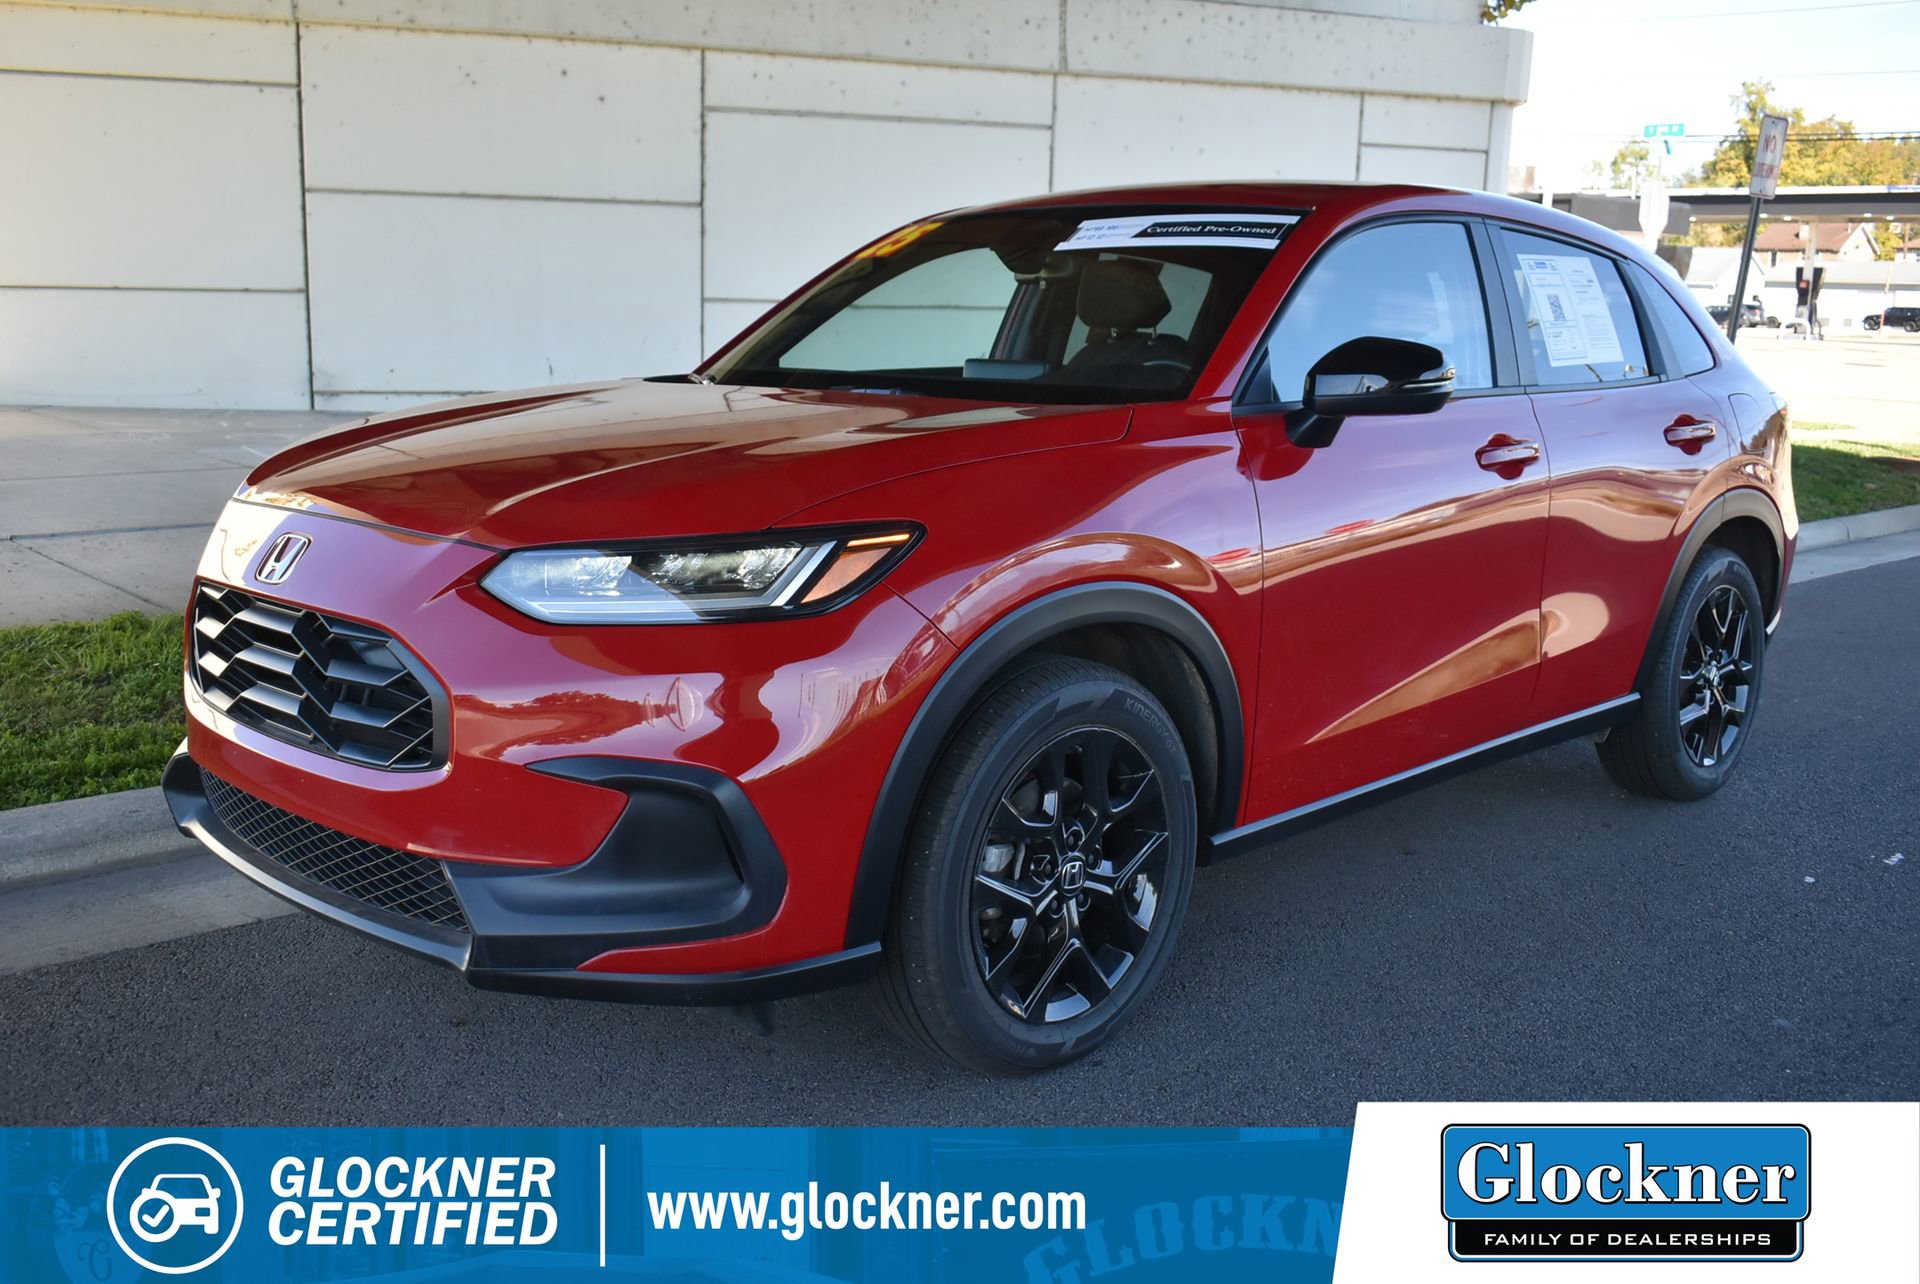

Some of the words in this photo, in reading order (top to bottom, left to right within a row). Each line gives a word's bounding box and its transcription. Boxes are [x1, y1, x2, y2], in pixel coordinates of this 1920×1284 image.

[1762, 133, 1777, 154] NO
[1145, 221, 1203, 234] Certified
[1204, 223, 1278, 235] Pre-Owned
